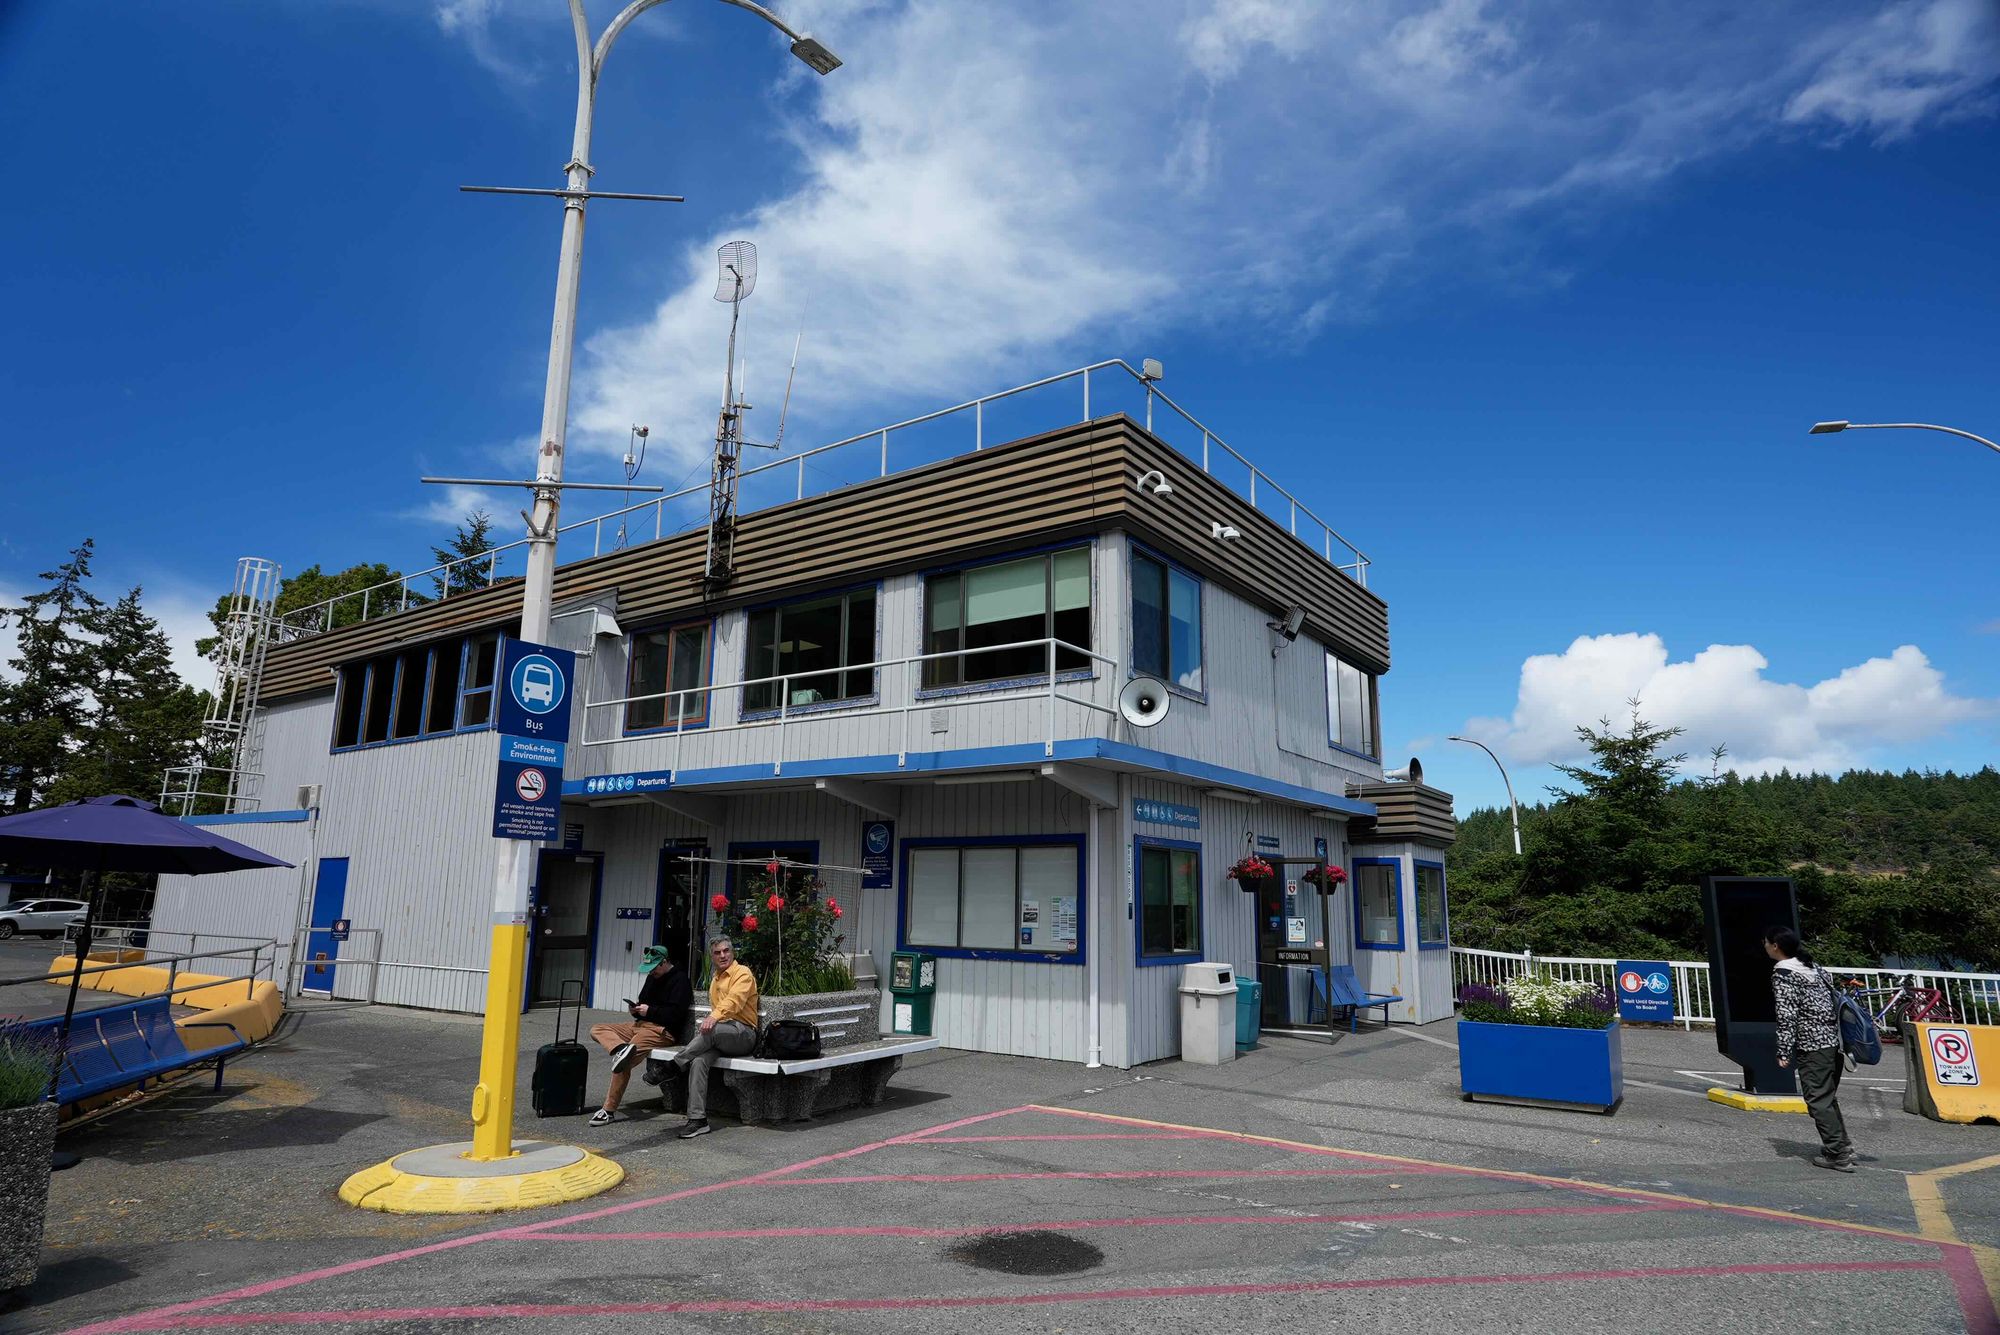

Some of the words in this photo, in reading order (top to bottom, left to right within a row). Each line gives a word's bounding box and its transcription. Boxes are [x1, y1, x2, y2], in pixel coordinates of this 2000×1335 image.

[526, 719, 543, 730] Bus
[513, 742, 556, 754] Smoke-Free
[510, 750, 557, 763] Environment
[637, 778, 666, 787] Departures
[511, 817, 531, 825] Smoking
[1174, 811, 1198, 823] Departures
[1278, 952, 1309, 960] INFORMATION
